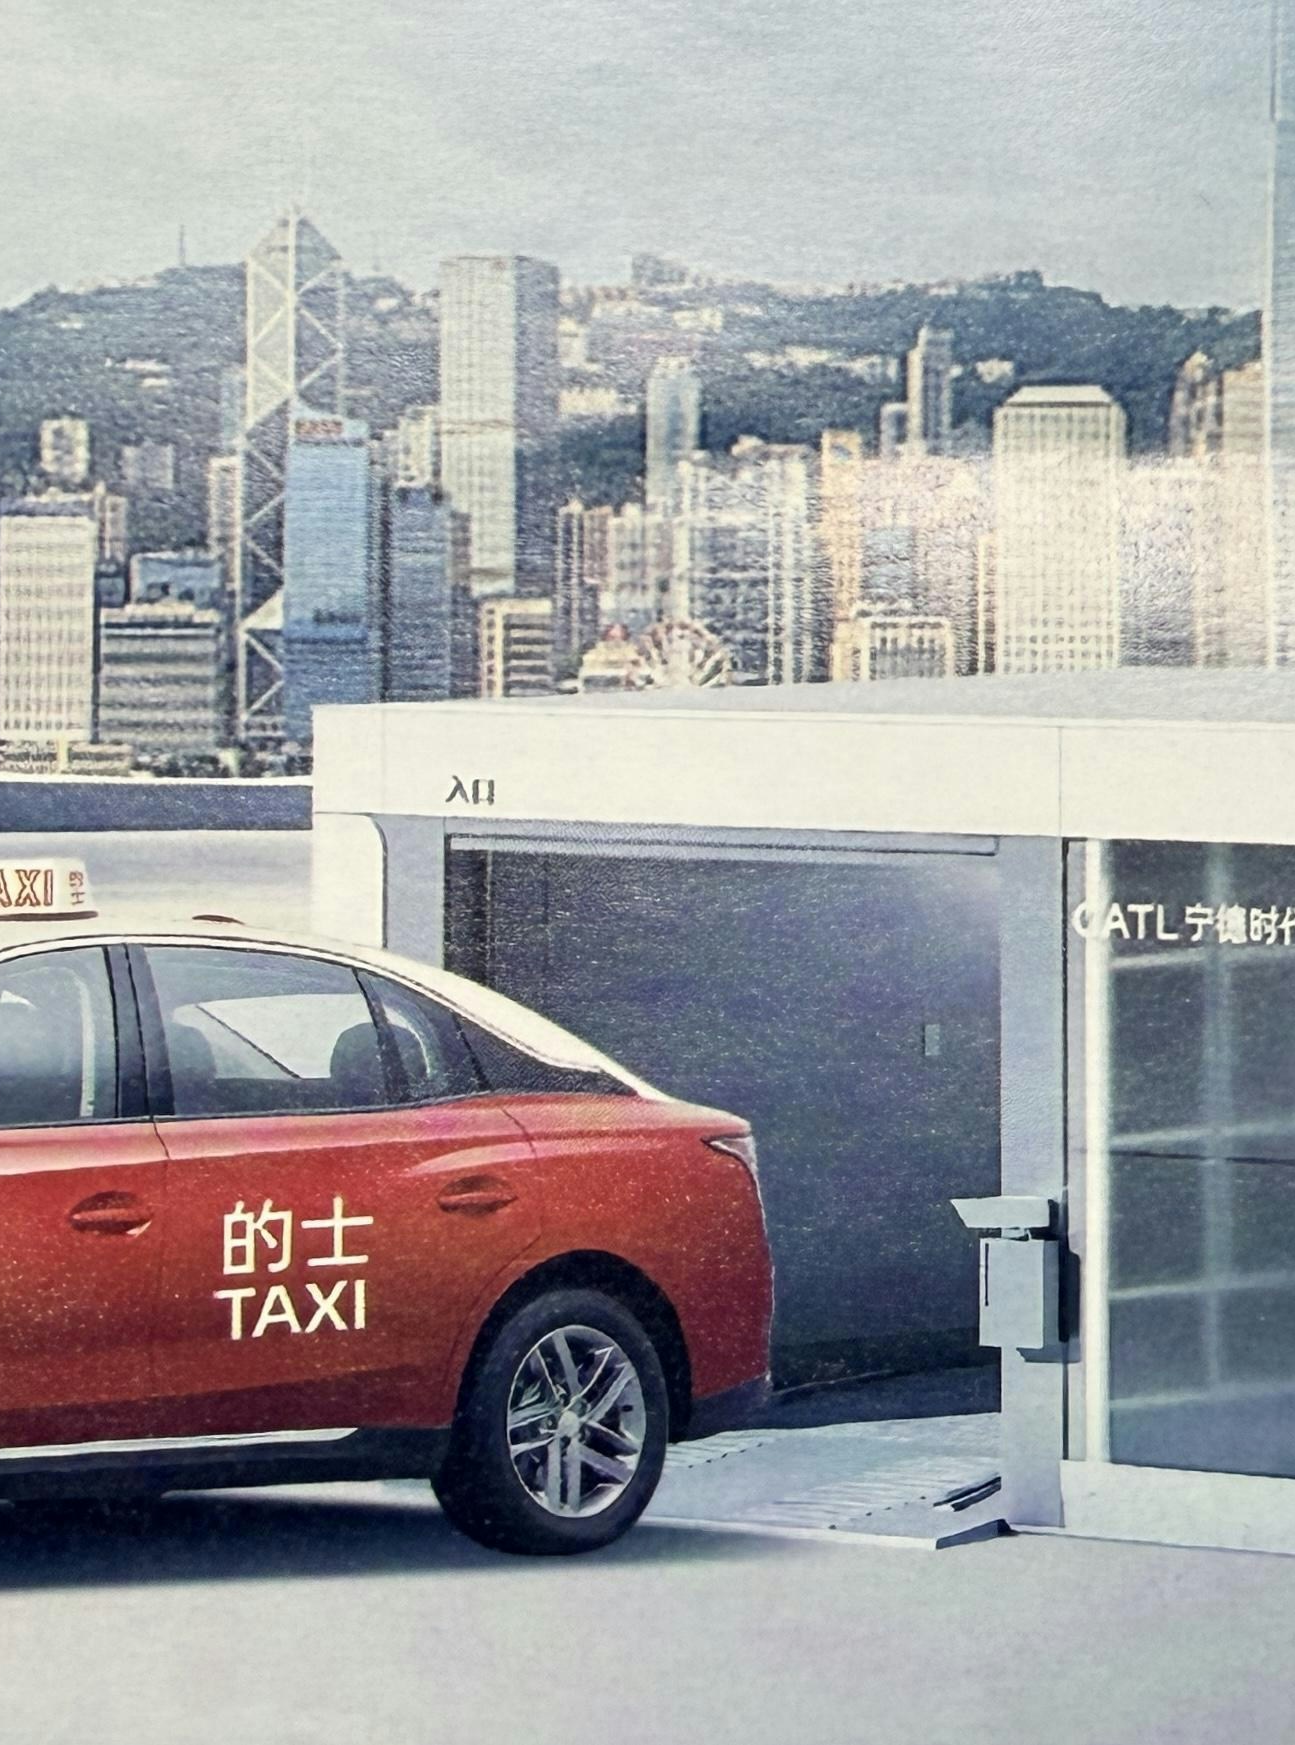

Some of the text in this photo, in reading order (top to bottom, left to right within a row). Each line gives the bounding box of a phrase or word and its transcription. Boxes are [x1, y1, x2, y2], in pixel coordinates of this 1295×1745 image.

[445, 775, 495, 806] 入口
[1072, 902, 1179, 940] CATL
[223, 1196, 374, 1275] 的士
[213, 1279, 366, 1340] TAXI
